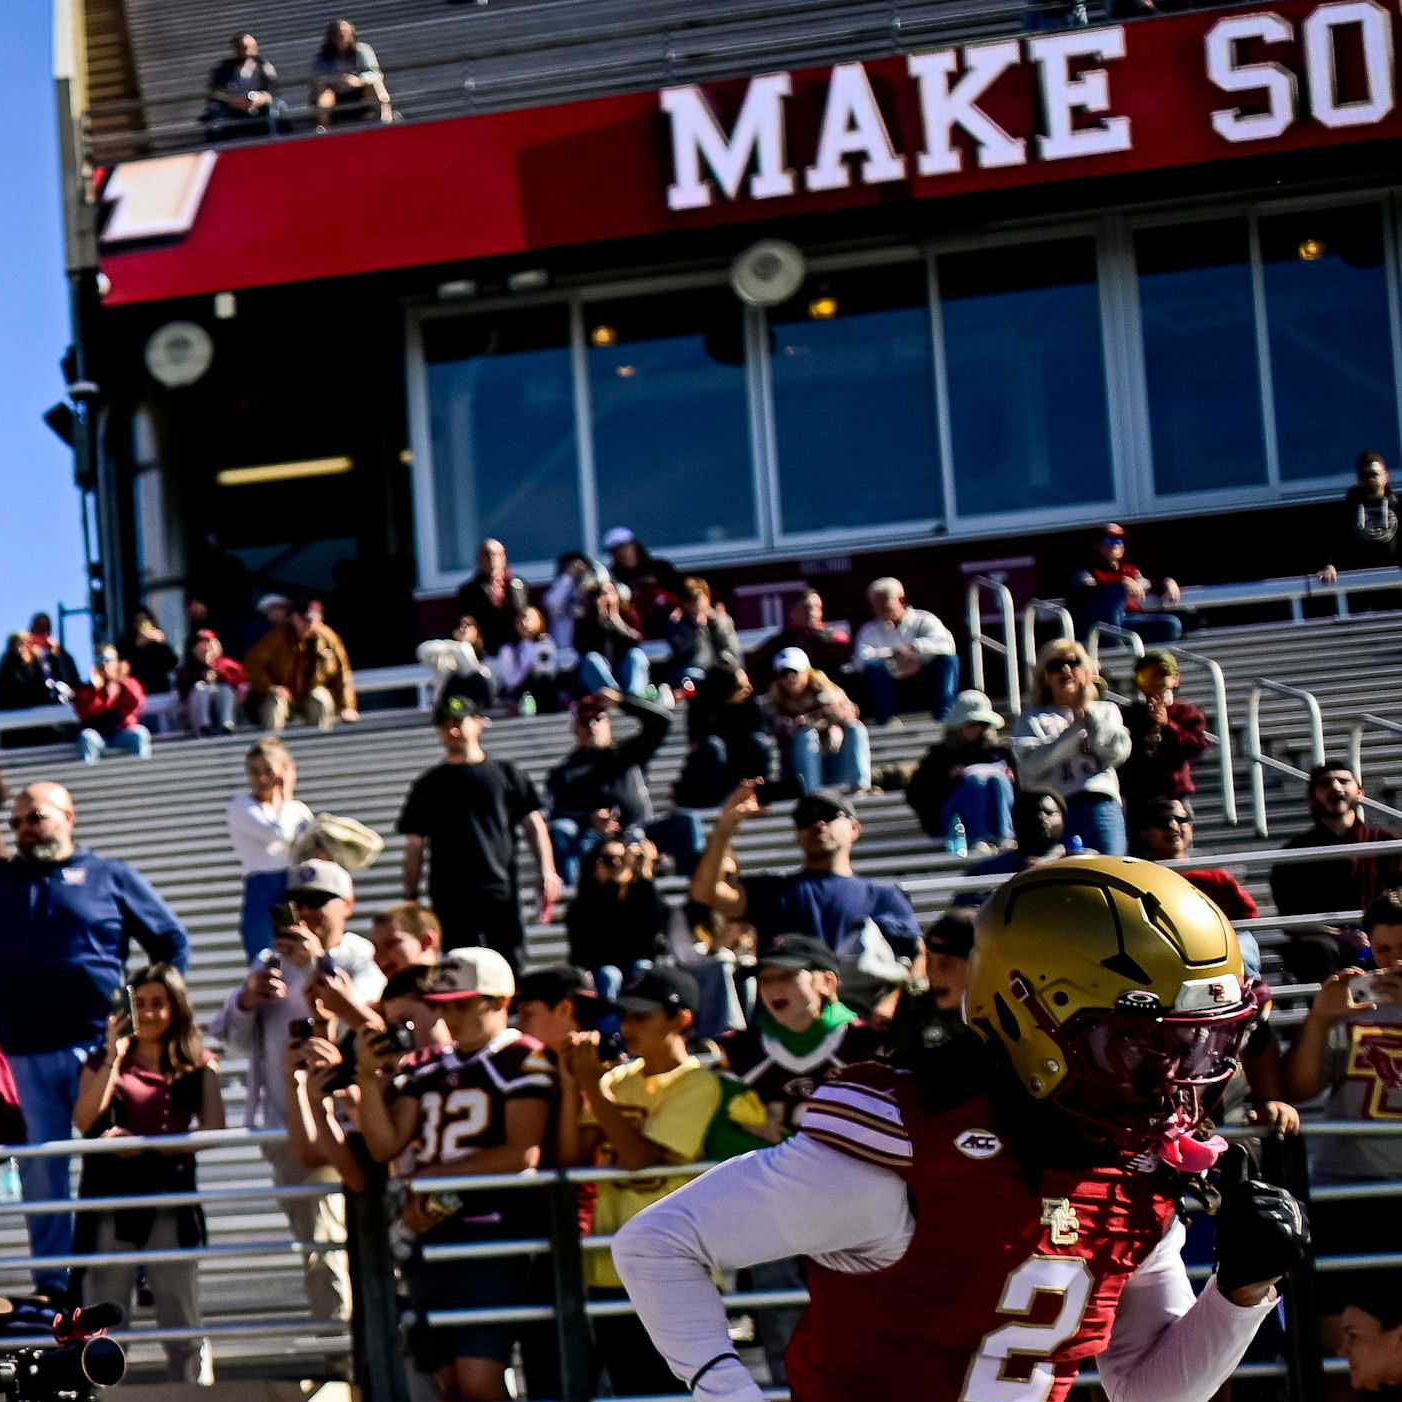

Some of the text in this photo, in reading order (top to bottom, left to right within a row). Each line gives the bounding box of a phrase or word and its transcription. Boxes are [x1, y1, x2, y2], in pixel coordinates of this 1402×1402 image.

[661, 2, 1394, 210] MAKE SO
[961, 1134, 998, 1150] ACC
